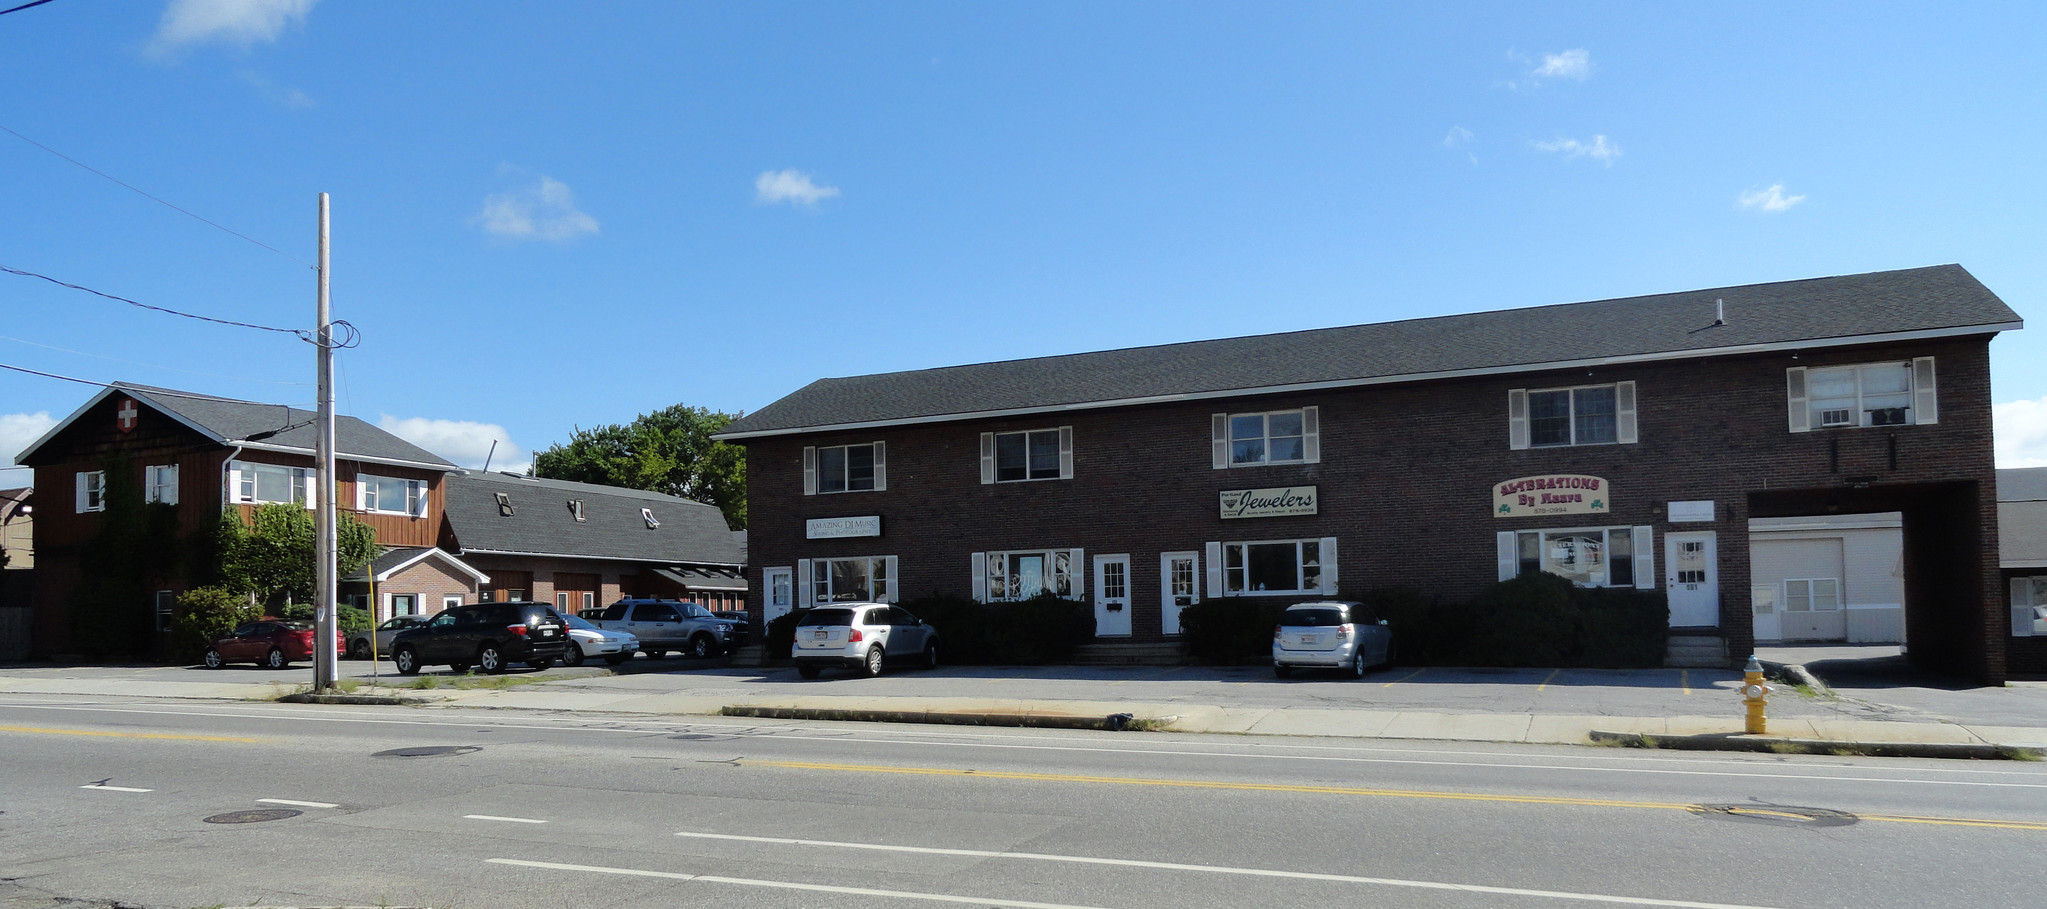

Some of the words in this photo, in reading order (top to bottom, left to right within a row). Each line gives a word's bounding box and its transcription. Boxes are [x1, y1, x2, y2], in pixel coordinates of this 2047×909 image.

[1500, 477, 1600, 496] ALTERATIONS
[1237, 489, 1314, 516] Jewelers
[1518, 494, 1535, 507] By
[810, 521, 843, 530] AMAZING
[845, 520, 854, 529] DJ
[855, 520, 876, 529] MUSIC
